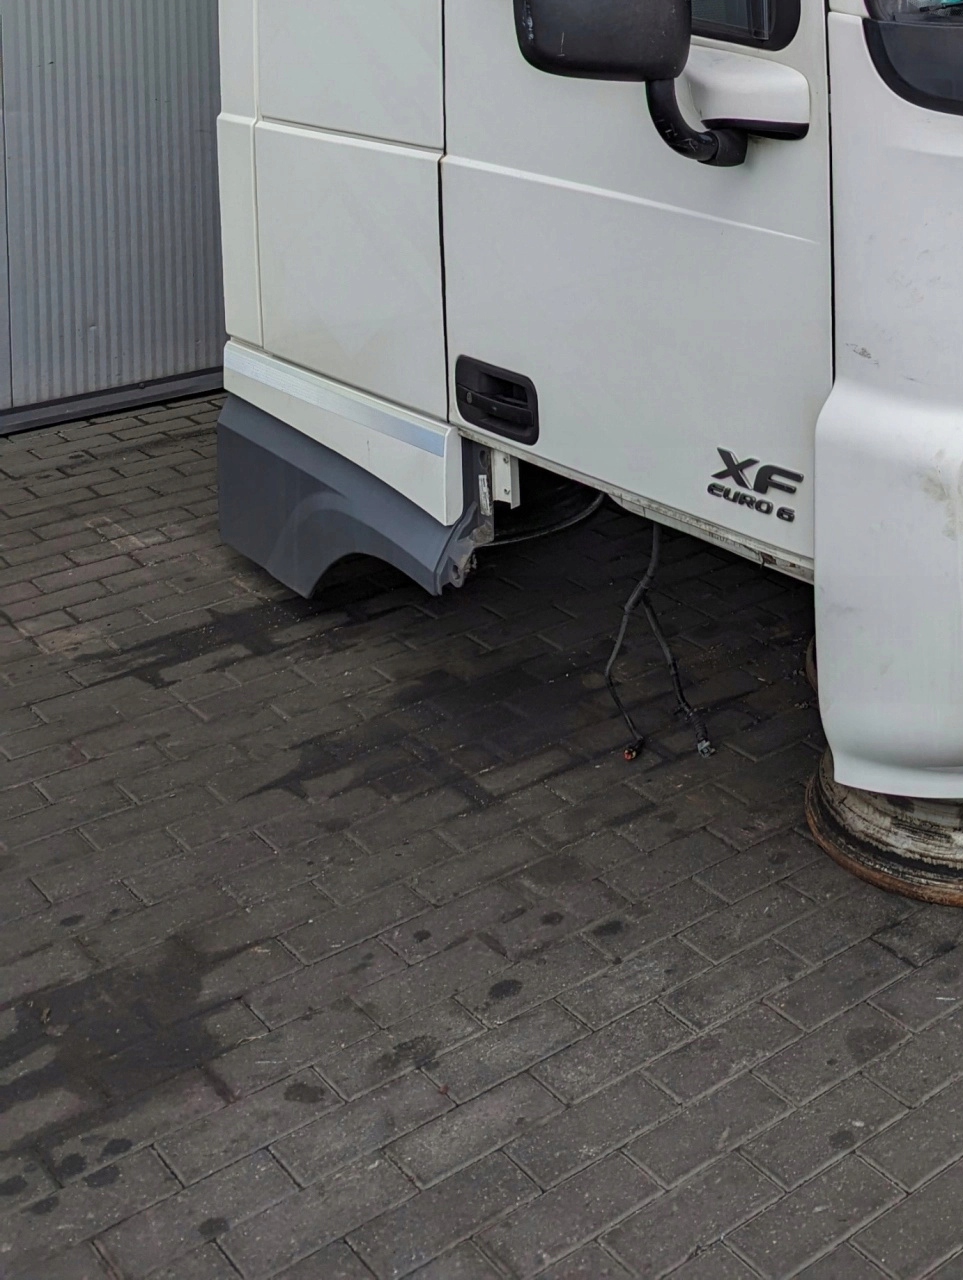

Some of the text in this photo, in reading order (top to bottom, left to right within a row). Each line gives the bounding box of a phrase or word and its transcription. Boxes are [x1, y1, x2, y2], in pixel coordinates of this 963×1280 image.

[711, 447, 804, 494] XF
[707, 483, 795, 522] EURO 6
